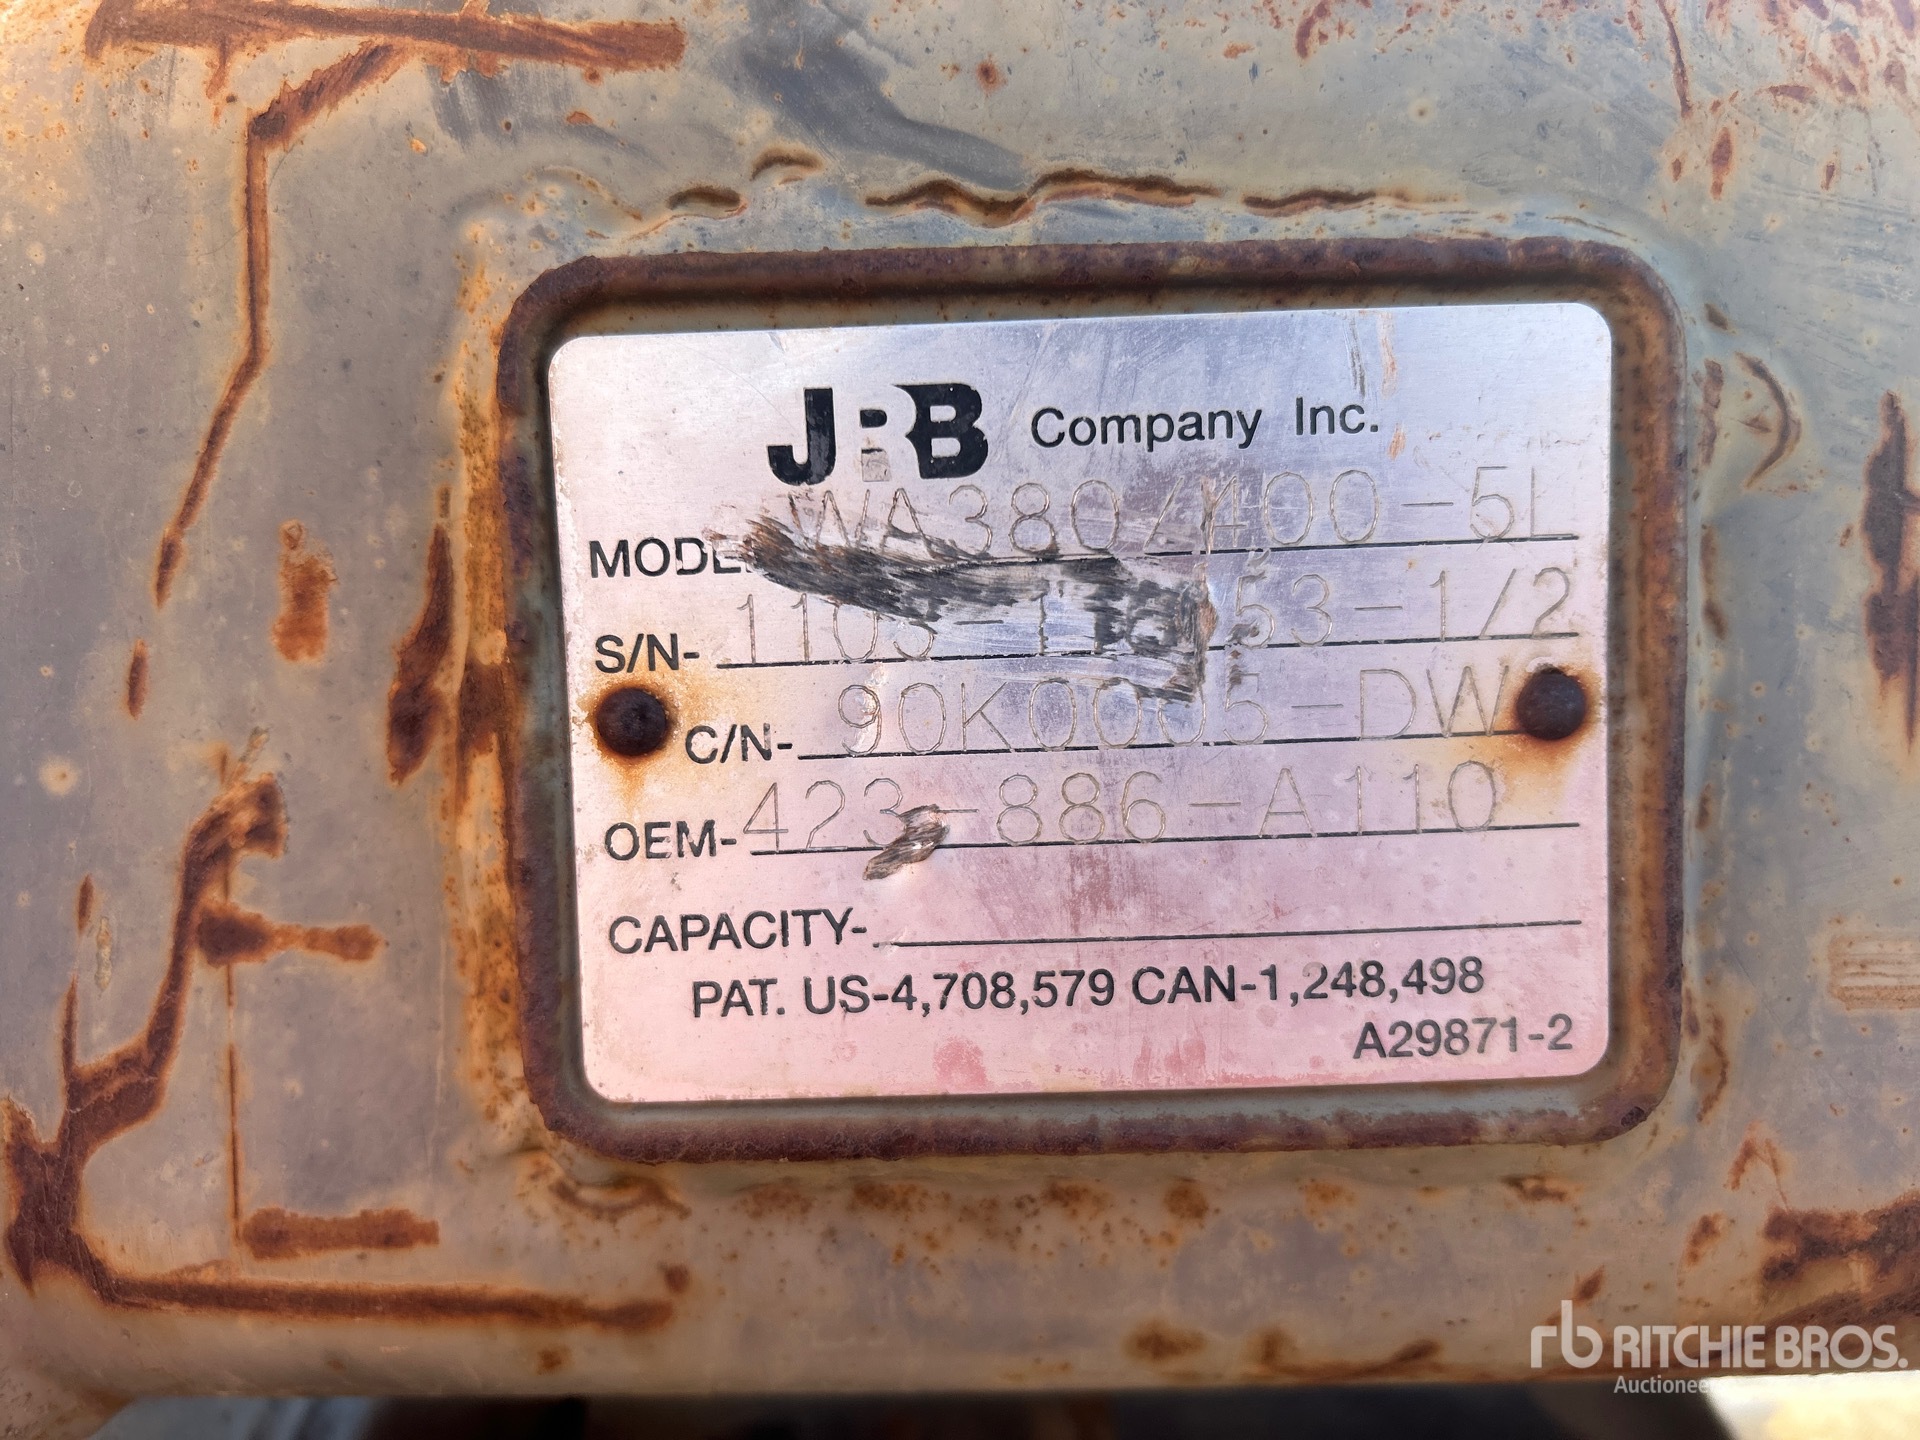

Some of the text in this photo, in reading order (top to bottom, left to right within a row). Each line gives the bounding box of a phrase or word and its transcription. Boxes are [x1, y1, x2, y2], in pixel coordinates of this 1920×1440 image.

[767, 383, 1380, 486] JRB Company Inc.
[588, 536, 755, 579] MODE
[595, 632, 701, 674] S/N-
[685, 665, 1510, 764] C/N- 90K0005-DW
[604, 760, 1498, 861] OEM- 423-886-A110
[608, 907, 868, 954] CAPACITY-
[693, 955, 1485, 1018] PAT. US-4,708,579 CAN-1,248,498
[1353, 1012, 1574, 1060] A29871-2
